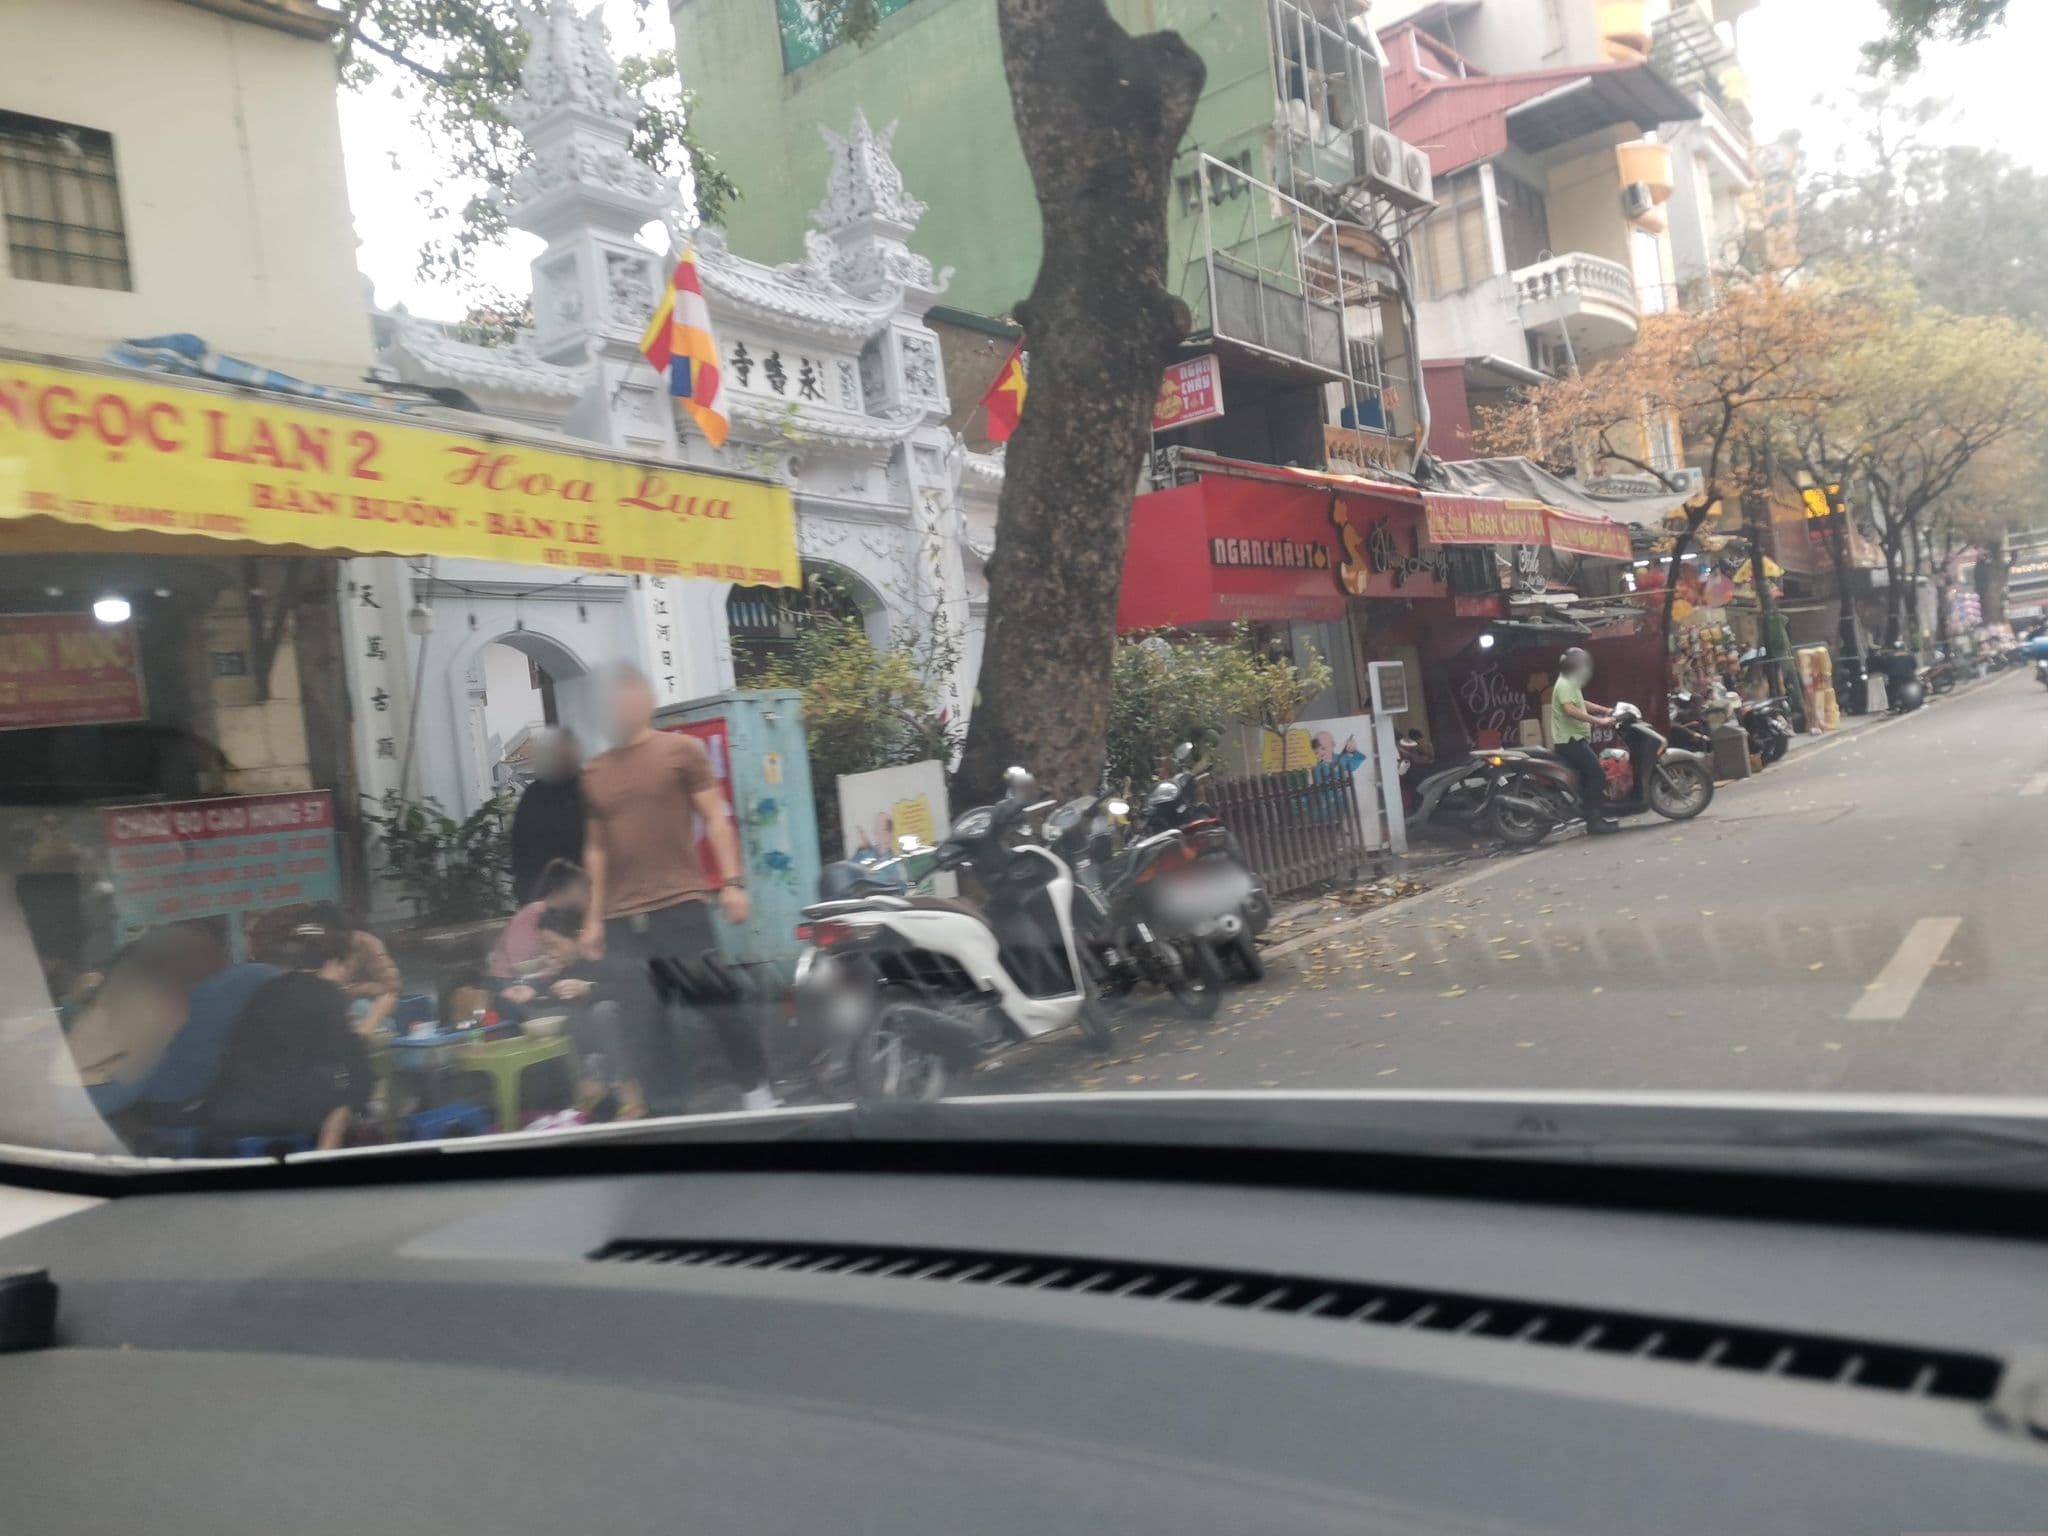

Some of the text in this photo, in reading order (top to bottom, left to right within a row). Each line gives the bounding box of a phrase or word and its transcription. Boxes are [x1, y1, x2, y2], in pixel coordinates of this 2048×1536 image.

[205, 409, 330, 473] LAN
[348, 429, 383, 480] 2
[443, 446, 736, 521] Hoa Lụa
